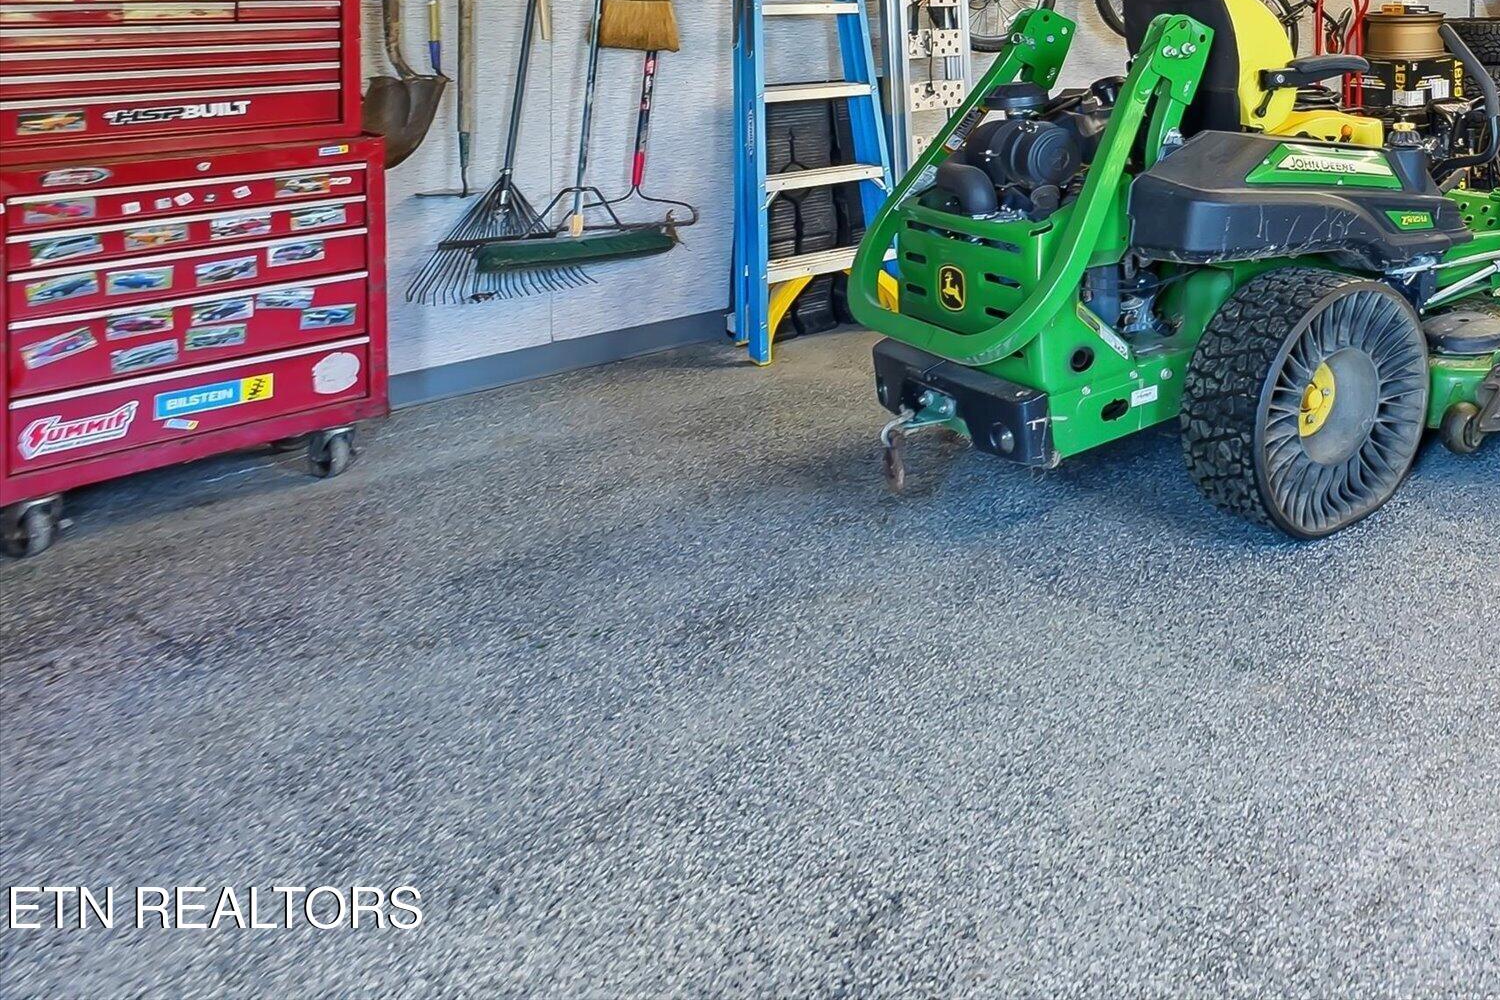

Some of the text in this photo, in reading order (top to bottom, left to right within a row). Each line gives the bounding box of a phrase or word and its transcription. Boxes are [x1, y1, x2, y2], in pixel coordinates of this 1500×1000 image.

[1290, 156, 1356, 172] JOHN DEERE
[165, 388, 234, 411] BILSTEIN
[22, 405, 136, 452] SUMMIT
